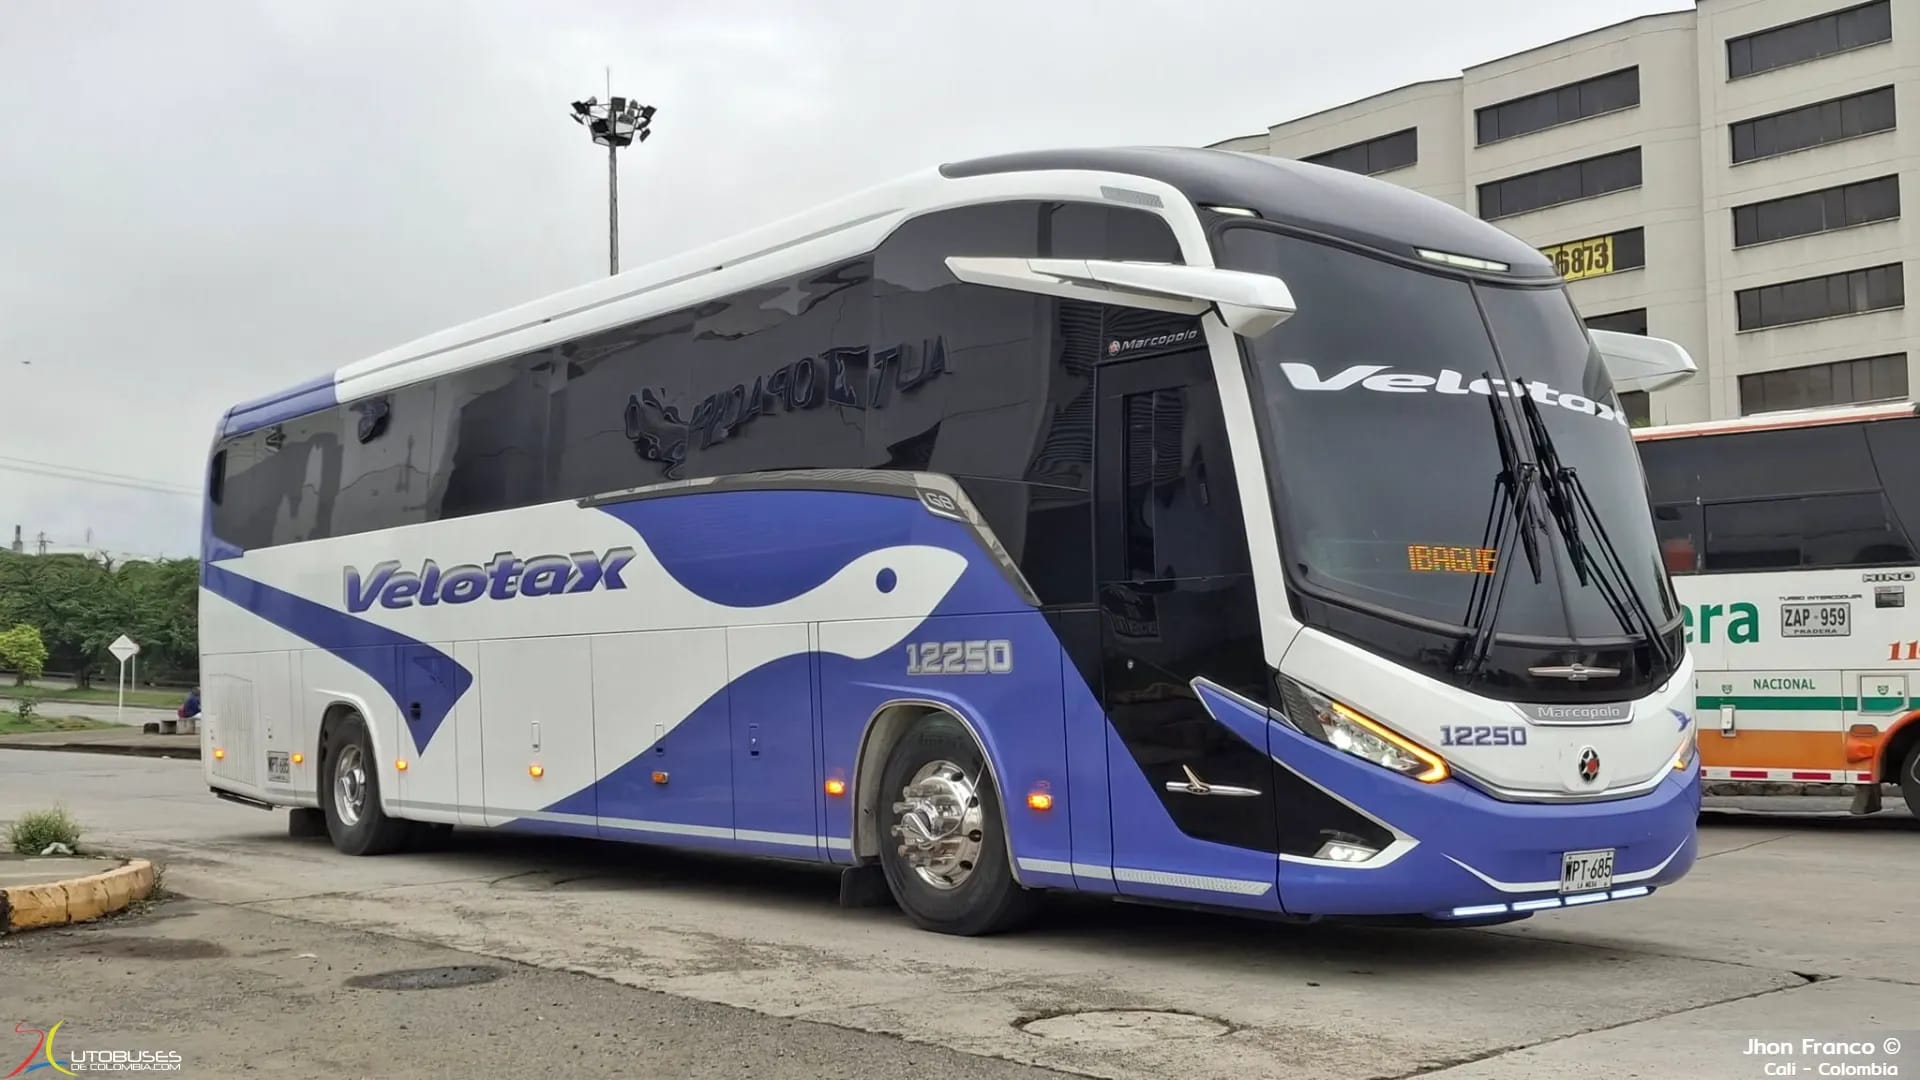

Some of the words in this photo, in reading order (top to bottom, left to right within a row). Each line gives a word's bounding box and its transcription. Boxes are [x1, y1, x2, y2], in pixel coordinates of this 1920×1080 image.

[1544, 242, 1609, 277] 6873
[1121, 329, 1198, 351] Marcopolo
[1280, 362, 1627, 426] Velotax
[1408, 545, 1496, 573] IBAGUE
[343, 546, 636, 613] Velotax
[1862, 572, 1915, 582] HINO
[906, 639, 1013, 675] 12250
[1887, 640, 1920, 661] 11
[1753, 678, 1816, 690] NACIONAL
[1537, 704, 1620, 719] Marcopolo
[1440, 726, 1527, 746] 12250
